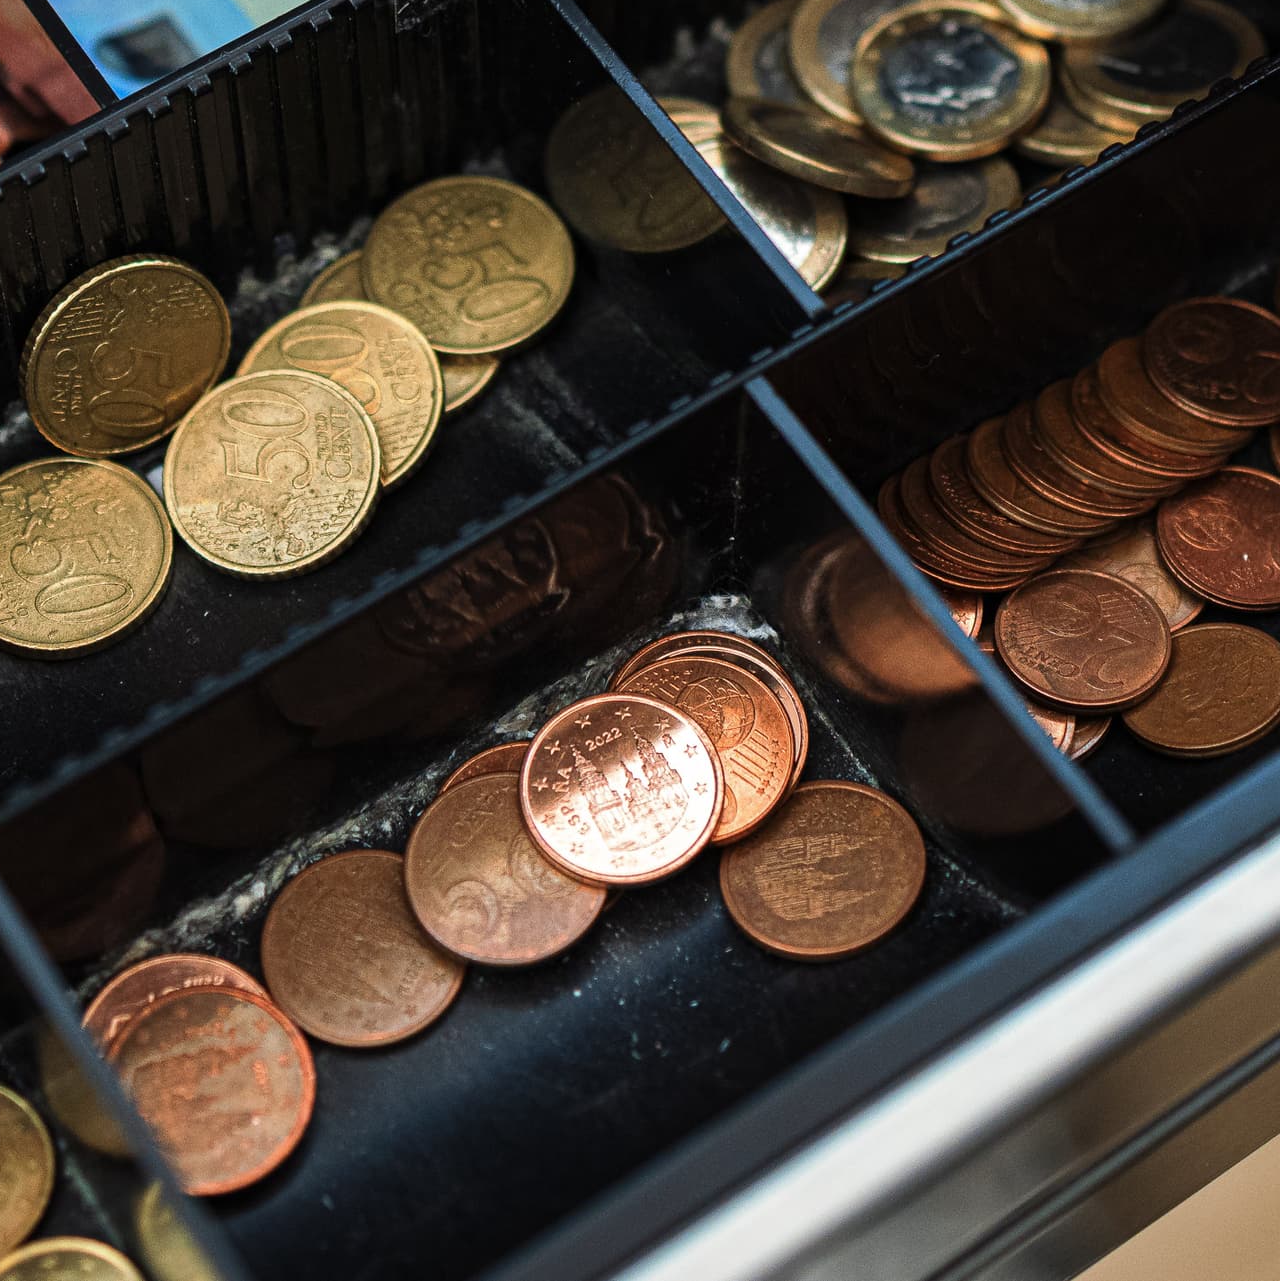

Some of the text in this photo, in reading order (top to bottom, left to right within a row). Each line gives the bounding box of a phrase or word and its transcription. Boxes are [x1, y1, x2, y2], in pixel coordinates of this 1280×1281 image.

[90, 340, 173, 429] 50
[223, 388, 313, 489] 50
[324, 406, 353, 483] CENT
[10, 533, 135, 623] 50
[584, 726, 623, 753] 2022
